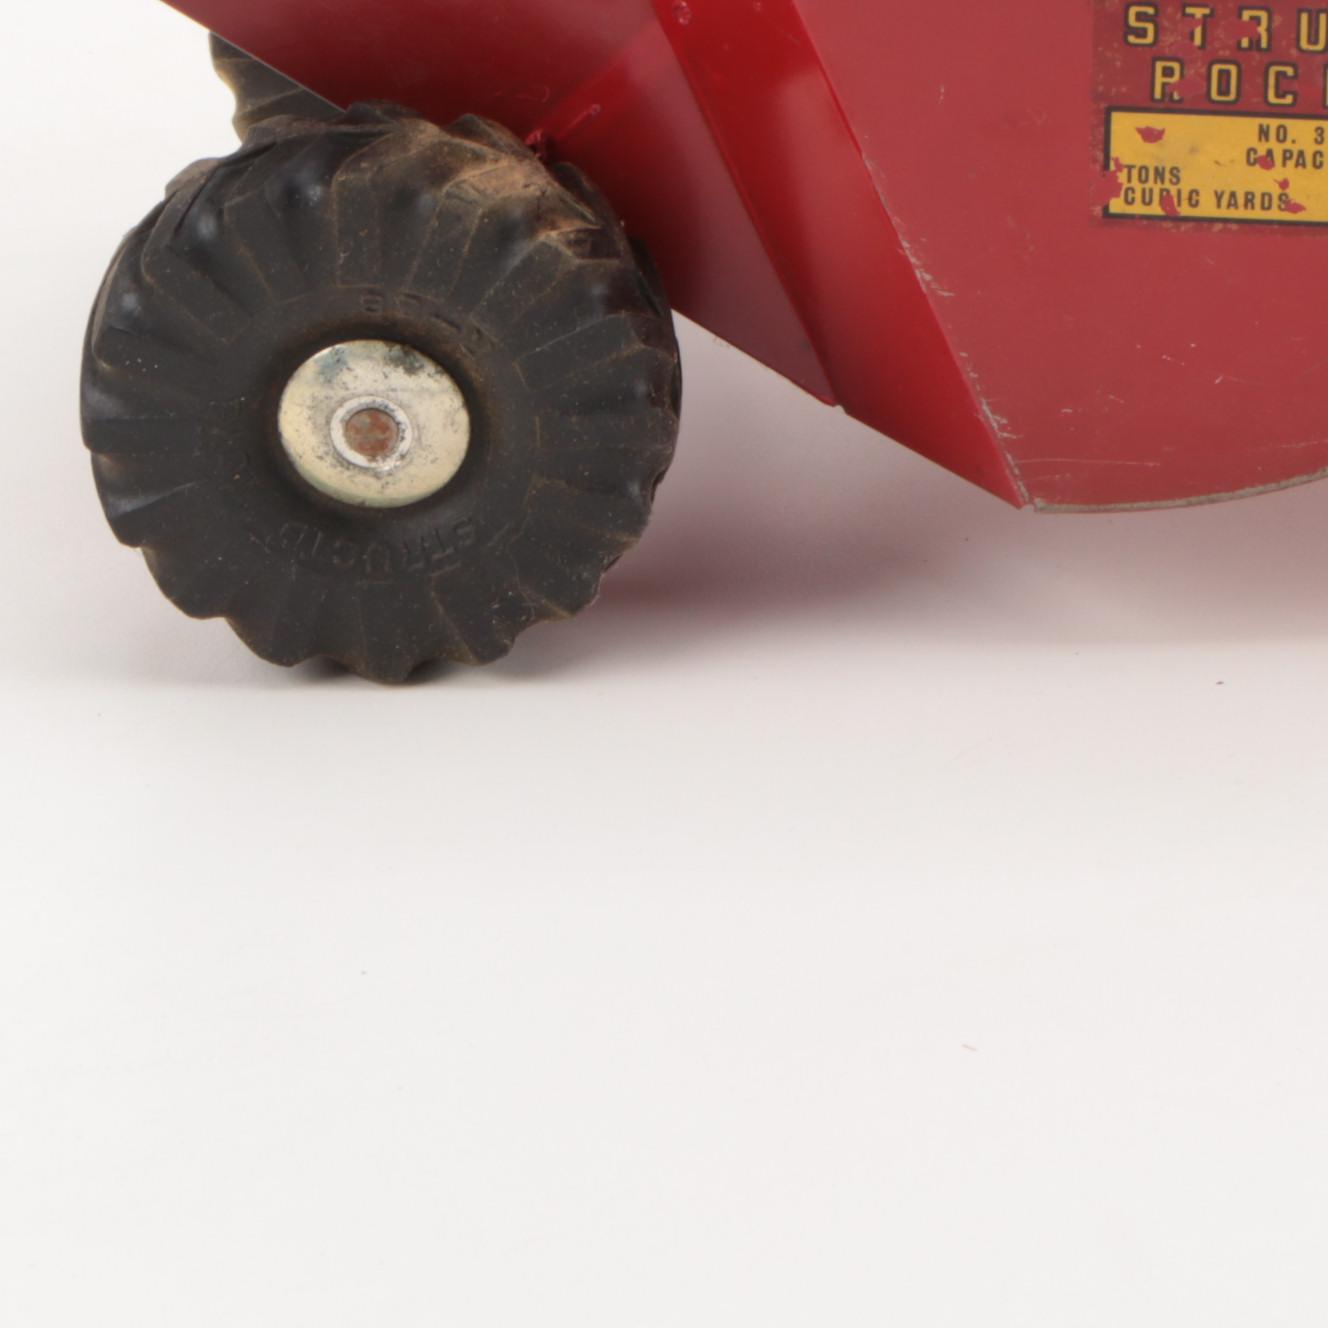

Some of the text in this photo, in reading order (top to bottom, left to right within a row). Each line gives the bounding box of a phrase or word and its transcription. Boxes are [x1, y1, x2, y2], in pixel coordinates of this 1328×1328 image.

[1257, 123, 1297, 145] NO.
[1124, 164, 1182, 185] TONS
[1214, 190, 1291, 212] YARDS
